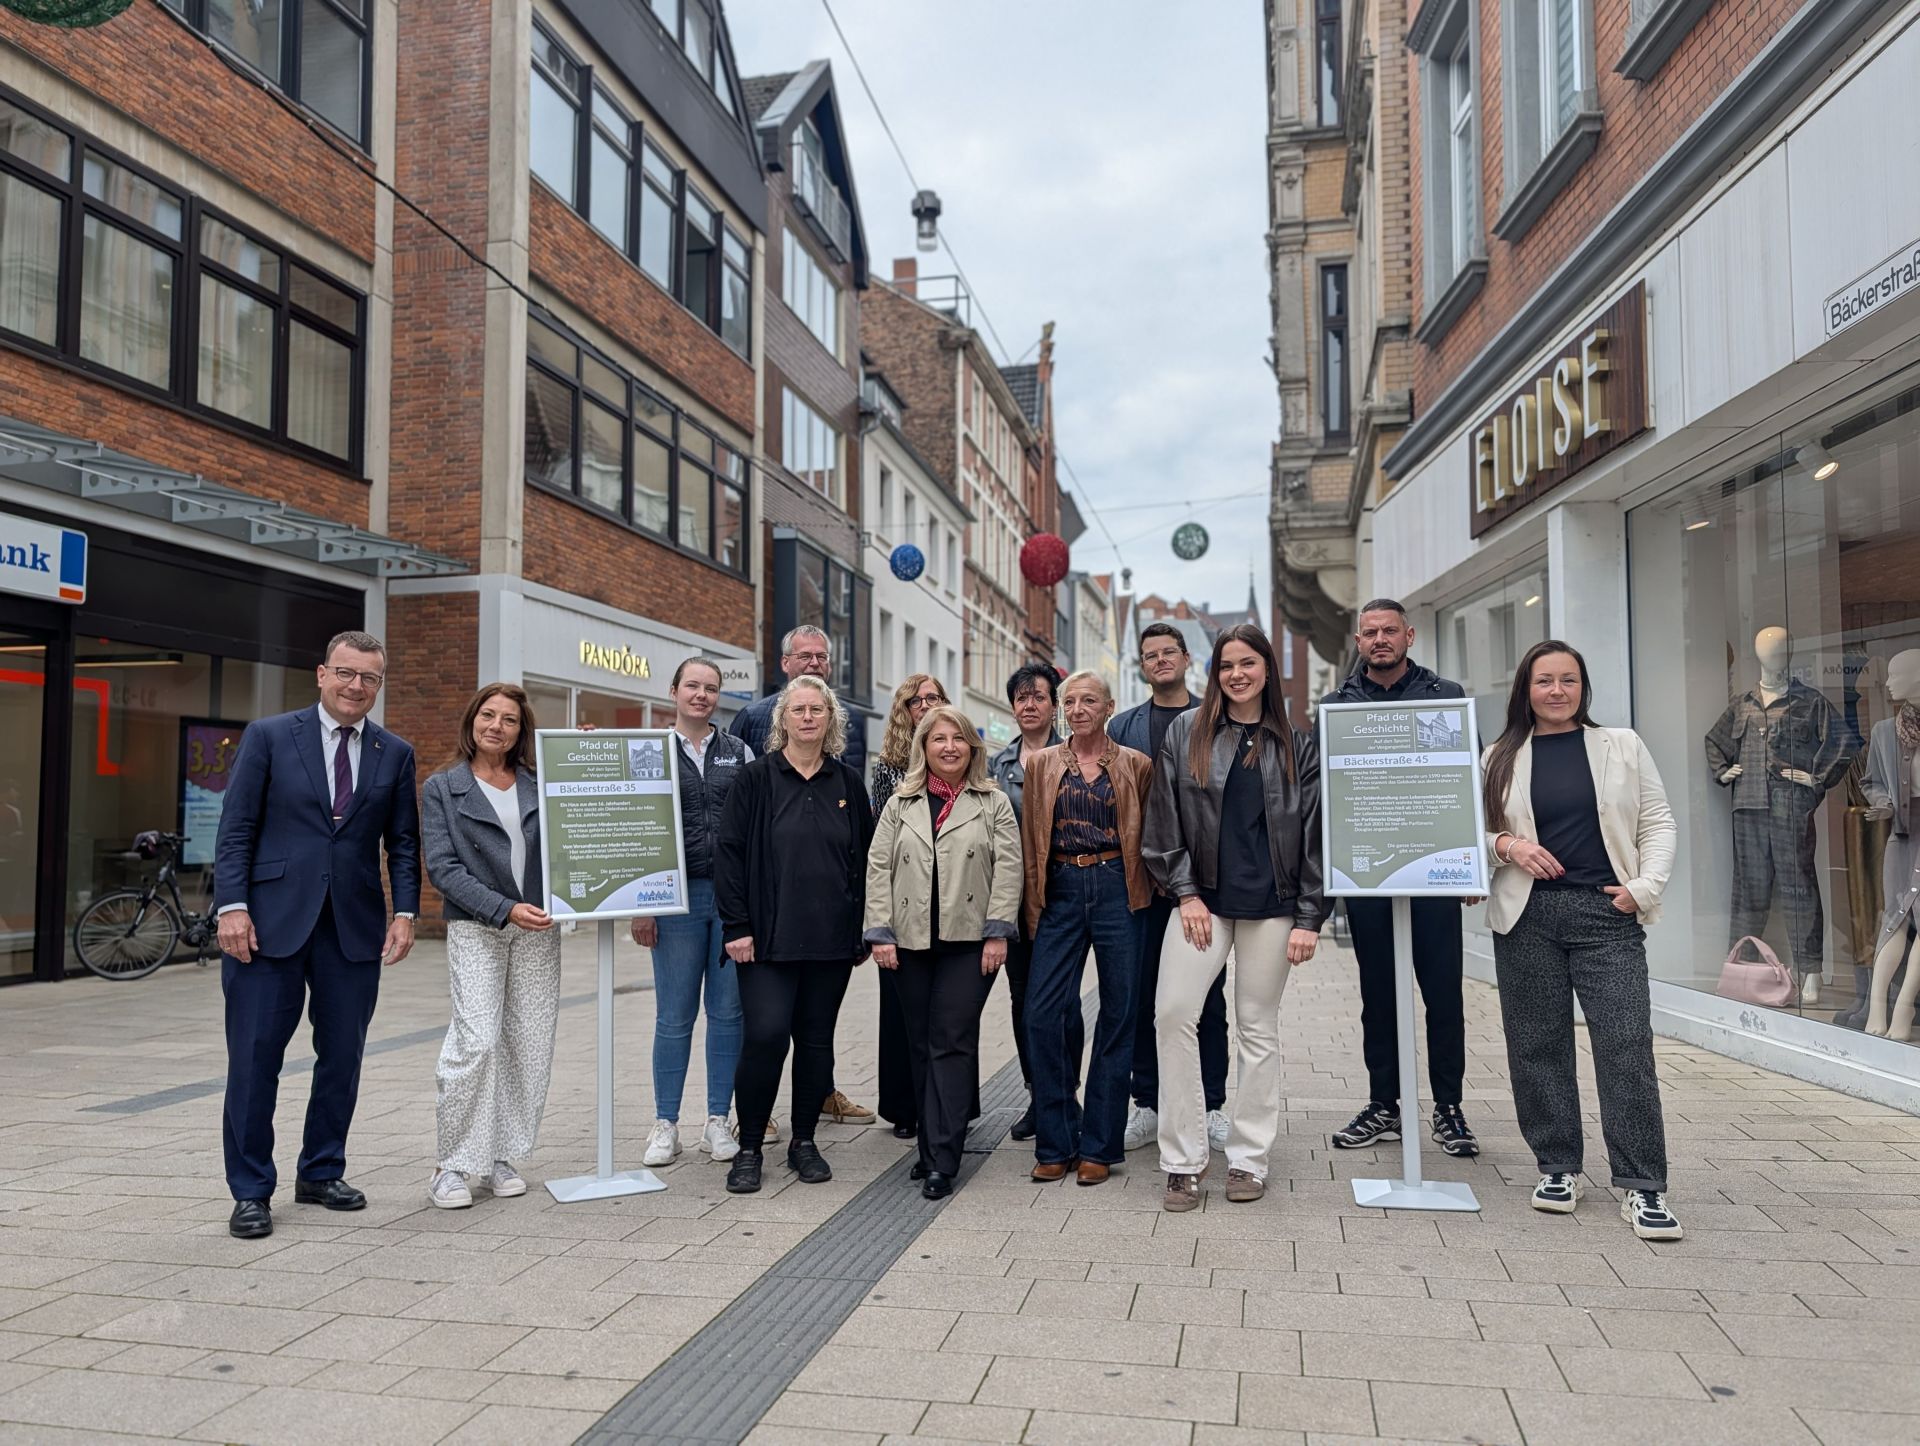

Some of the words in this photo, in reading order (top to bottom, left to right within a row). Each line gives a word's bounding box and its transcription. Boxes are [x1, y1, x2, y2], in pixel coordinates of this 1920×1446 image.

[1475, 329, 1610, 513] ELOISE
[580, 641, 651, 680] PANDORA
[1366, 713, 1390, 722] Pfad
[1392, 712, 1409, 721] der
[1353, 724, 1410, 734] Geschichte
[579, 741, 601, 750] Pfad
[603, 741, 618, 750] der
[567, 752, 619, 762] Geschichte
[1344, 756, 1412, 766] Bäckerstraße
[1415, 755, 1429, 764] 45
[560, 784, 622, 794] Bäckerstraße
[624, 784, 636, 793] 35
